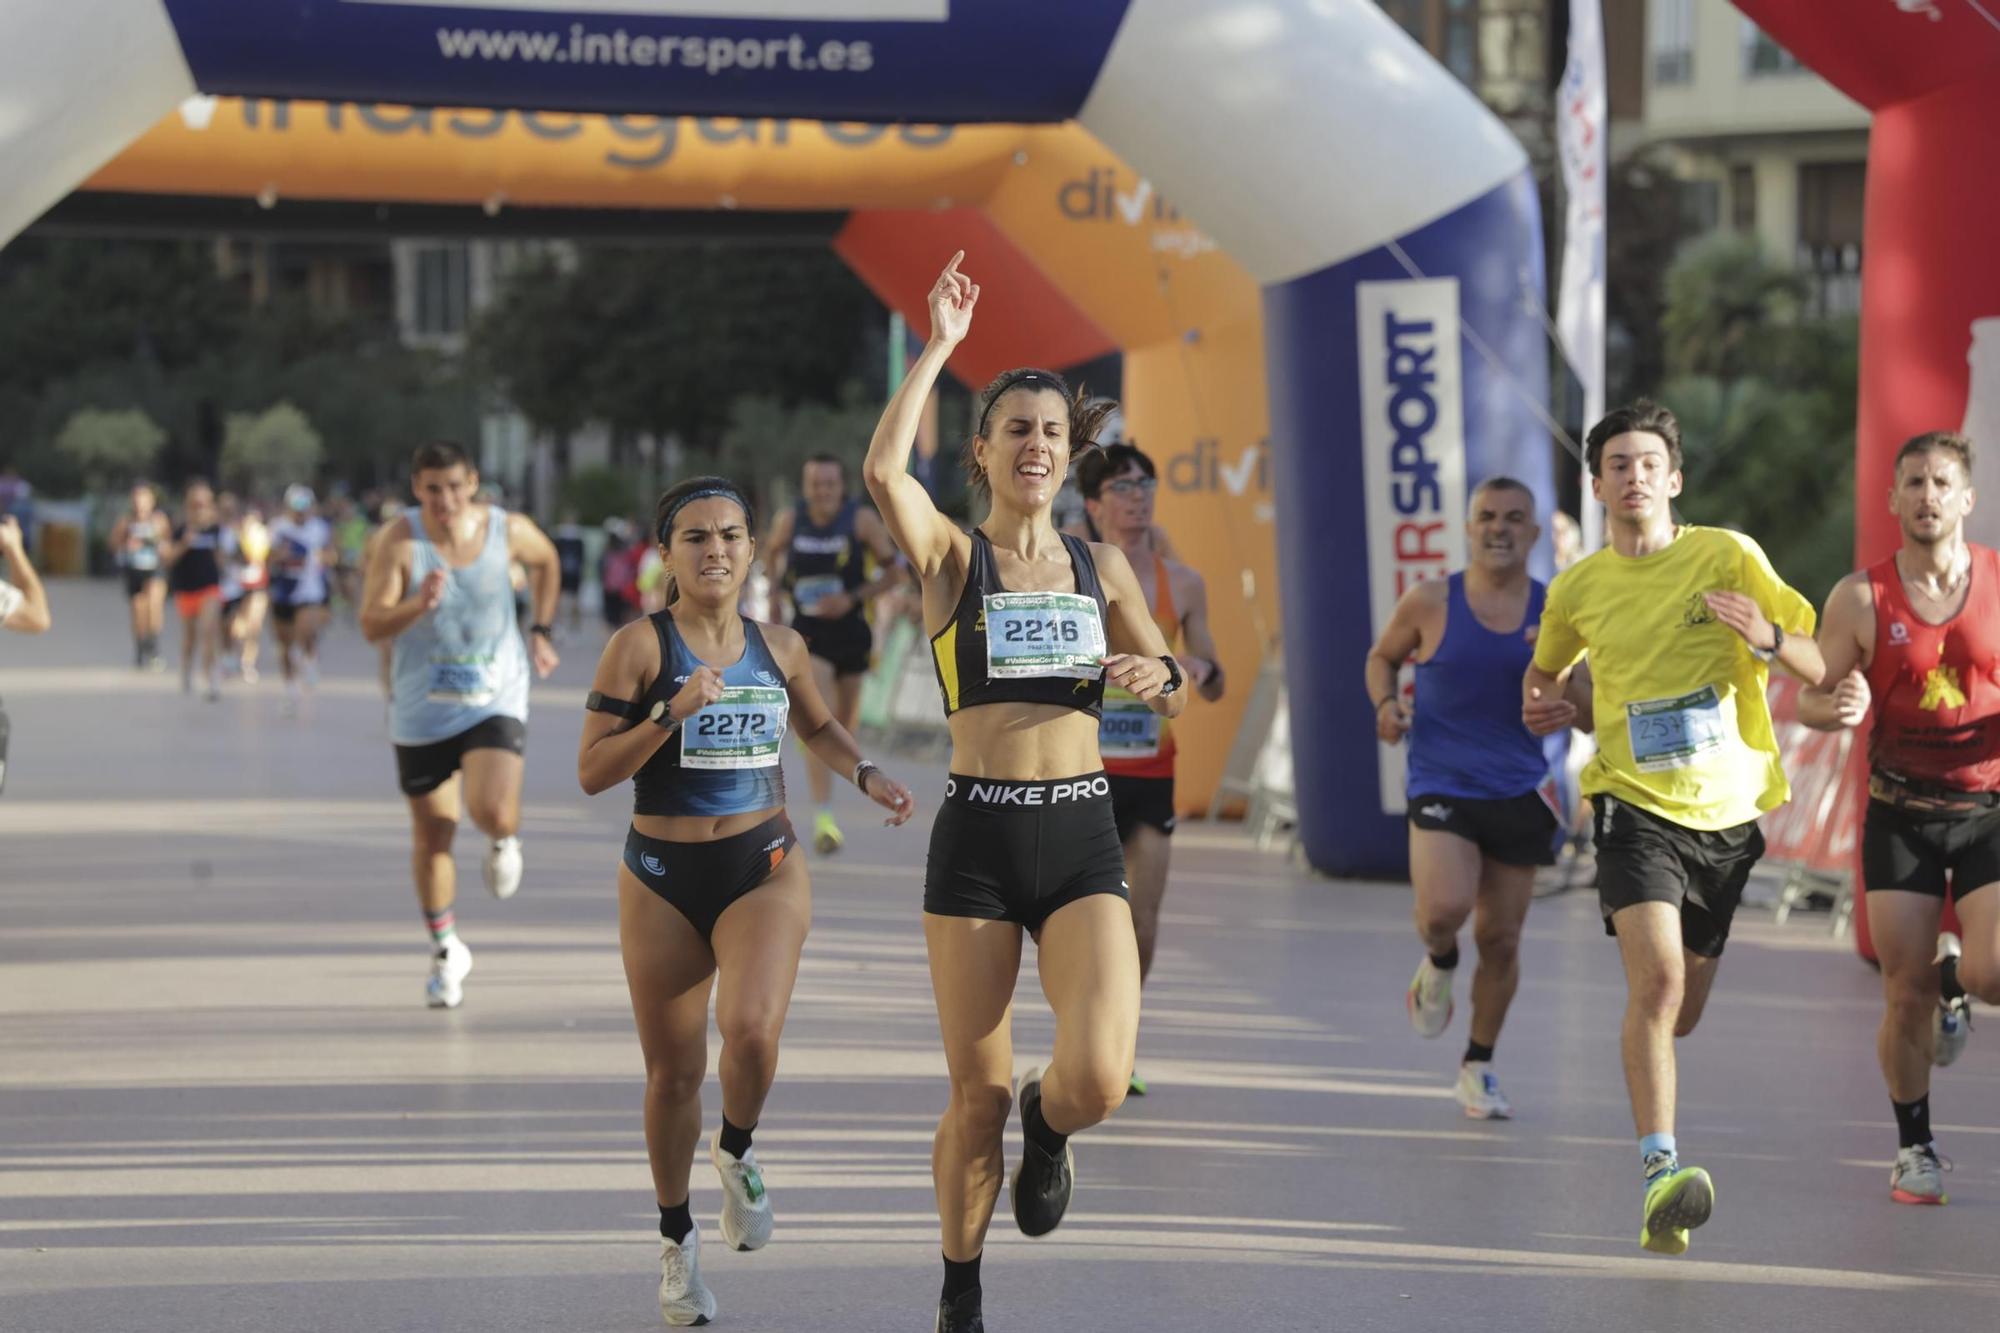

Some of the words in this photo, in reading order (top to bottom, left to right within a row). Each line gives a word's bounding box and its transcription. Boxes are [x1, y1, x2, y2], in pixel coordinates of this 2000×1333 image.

[436, 23, 875, 76] www.intersport.es
[1004, 619, 1079, 642] 2216
[698, 713, 767, 736] 2272
[968, 783, 1046, 806] NIKE
[1050, 776, 1109, 804] PRO
